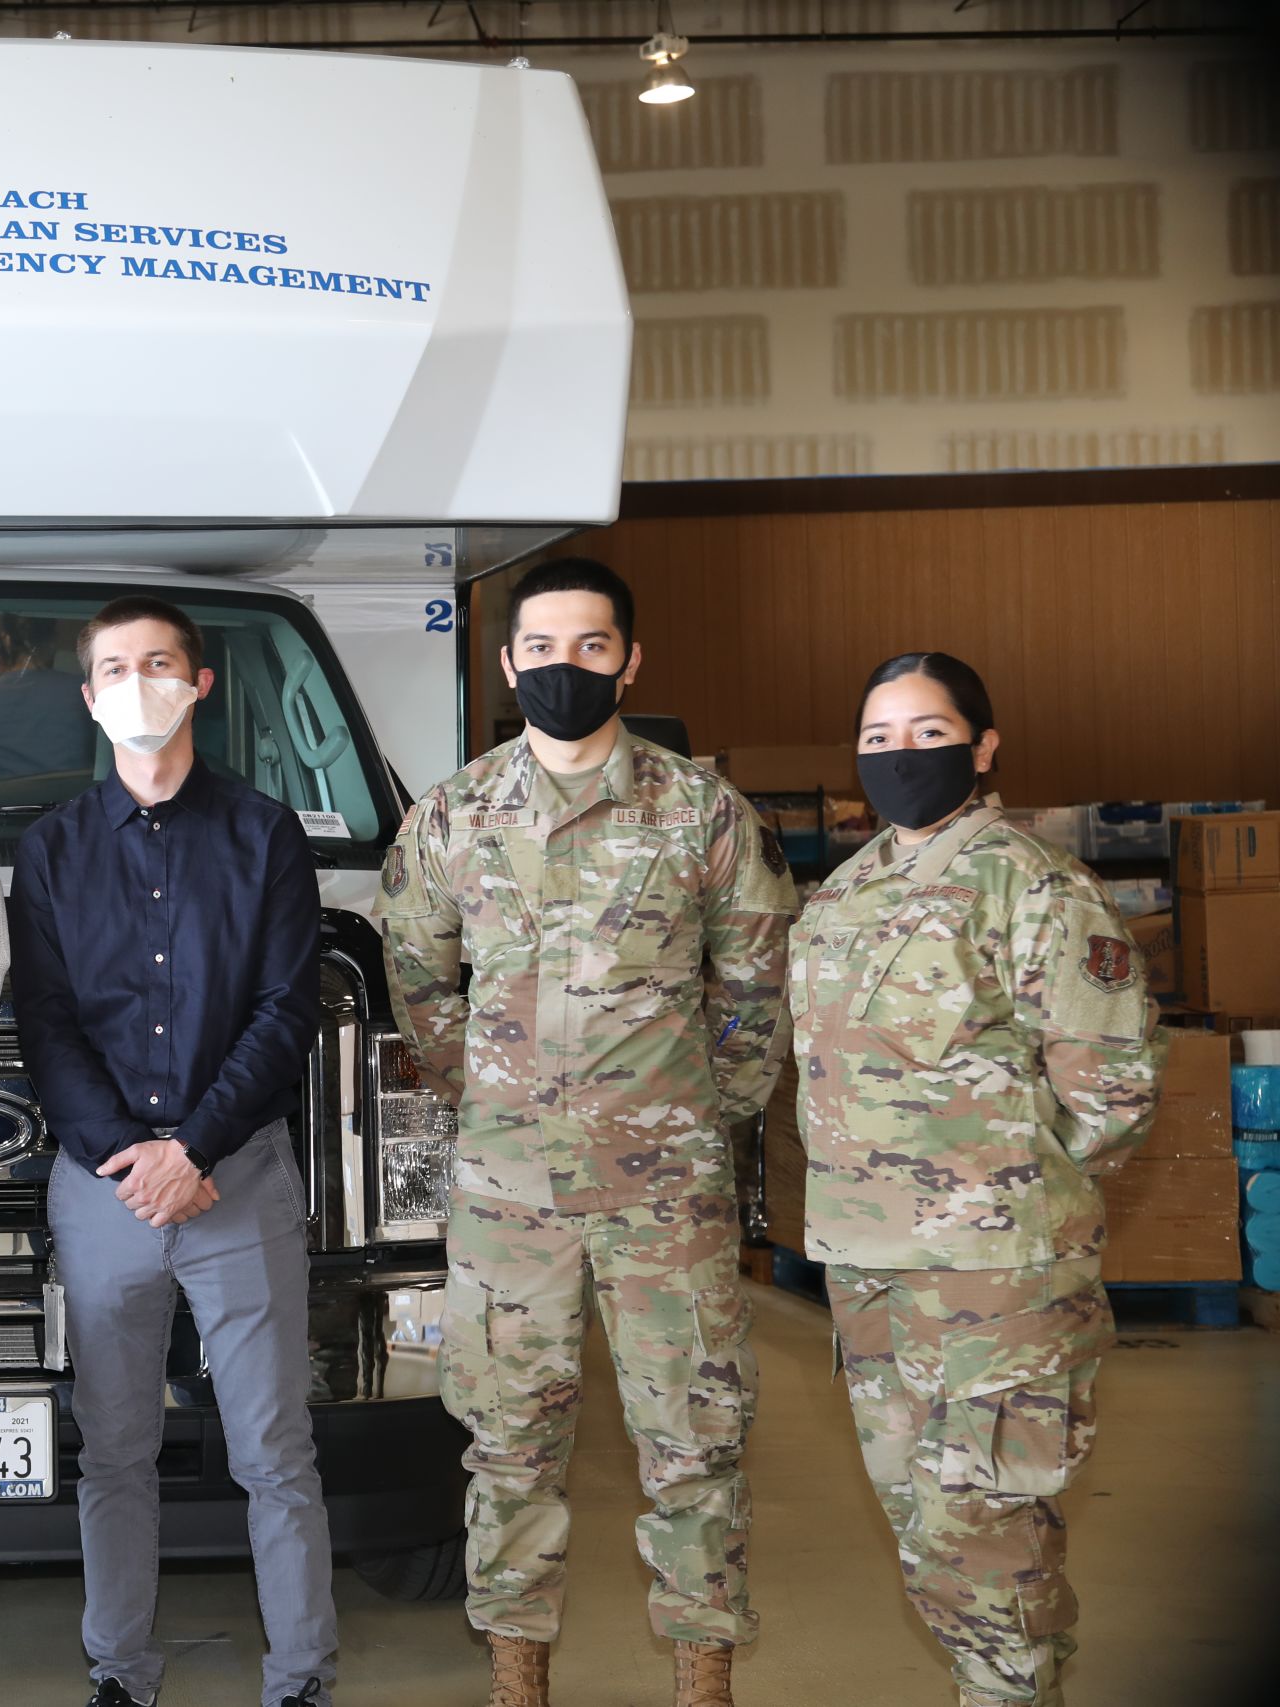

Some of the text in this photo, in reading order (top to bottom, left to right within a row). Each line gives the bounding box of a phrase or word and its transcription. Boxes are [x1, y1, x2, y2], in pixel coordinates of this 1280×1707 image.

[75, 223, 288, 255] SERVICES
[123, 256, 430, 302] MANAGEMENT
[425, 599, 453, 632] 2
[469, 812, 518, 828] VALENCIA
[659, 810, 695, 828] FORCE
[11, 1417, 30, 1425] 2021
